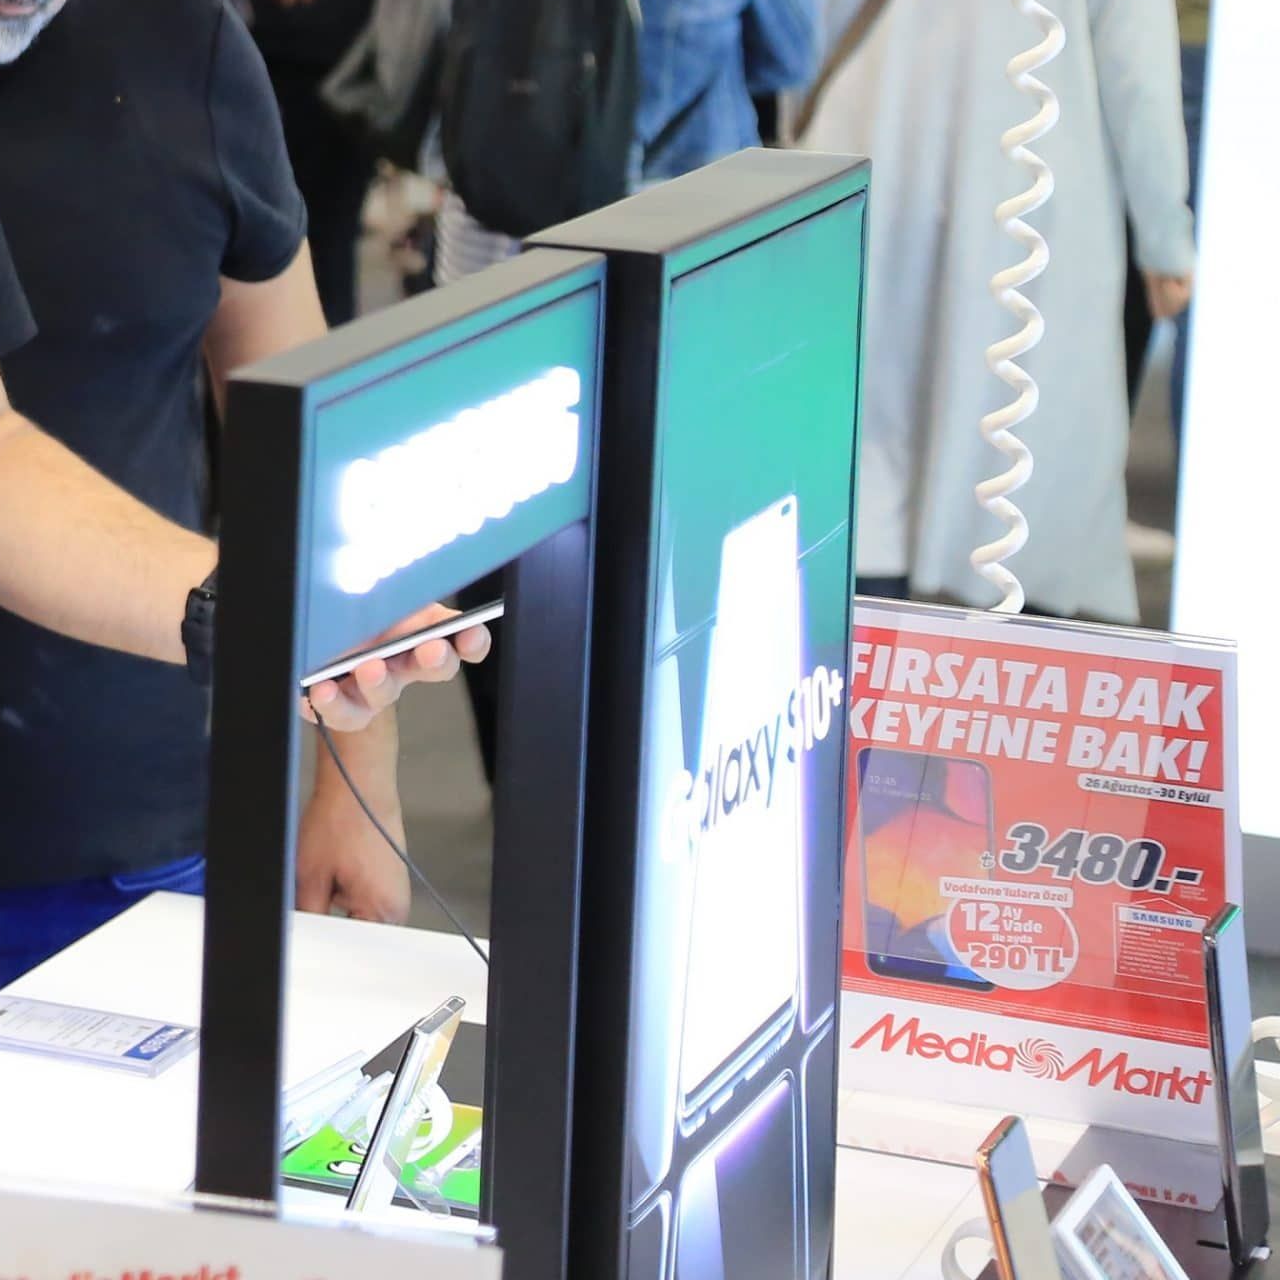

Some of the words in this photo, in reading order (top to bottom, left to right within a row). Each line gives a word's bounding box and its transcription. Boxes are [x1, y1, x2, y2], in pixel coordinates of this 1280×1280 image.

[851, 641, 1069, 714] FIRSATA
[1080, 669, 1215, 733] BAK
[1066, 725, 1209, 784] BAK!
[1177, 790, 1211, 804] Eylül
[999, 822, 1204, 894] 3480.-
[960, 901, 1000, 932] 12
[1001, 905, 1023, 920] Ay
[1002, 919, 1043, 933] Vade
[1131, 912, 1193, 928] SAMSUNG
[968, 942, 1029, 971] 290
[1031, 946, 1065, 973] TL
[850, 1013, 1018, 1073] Media
[1057, 1047, 1214, 1105] Markt
